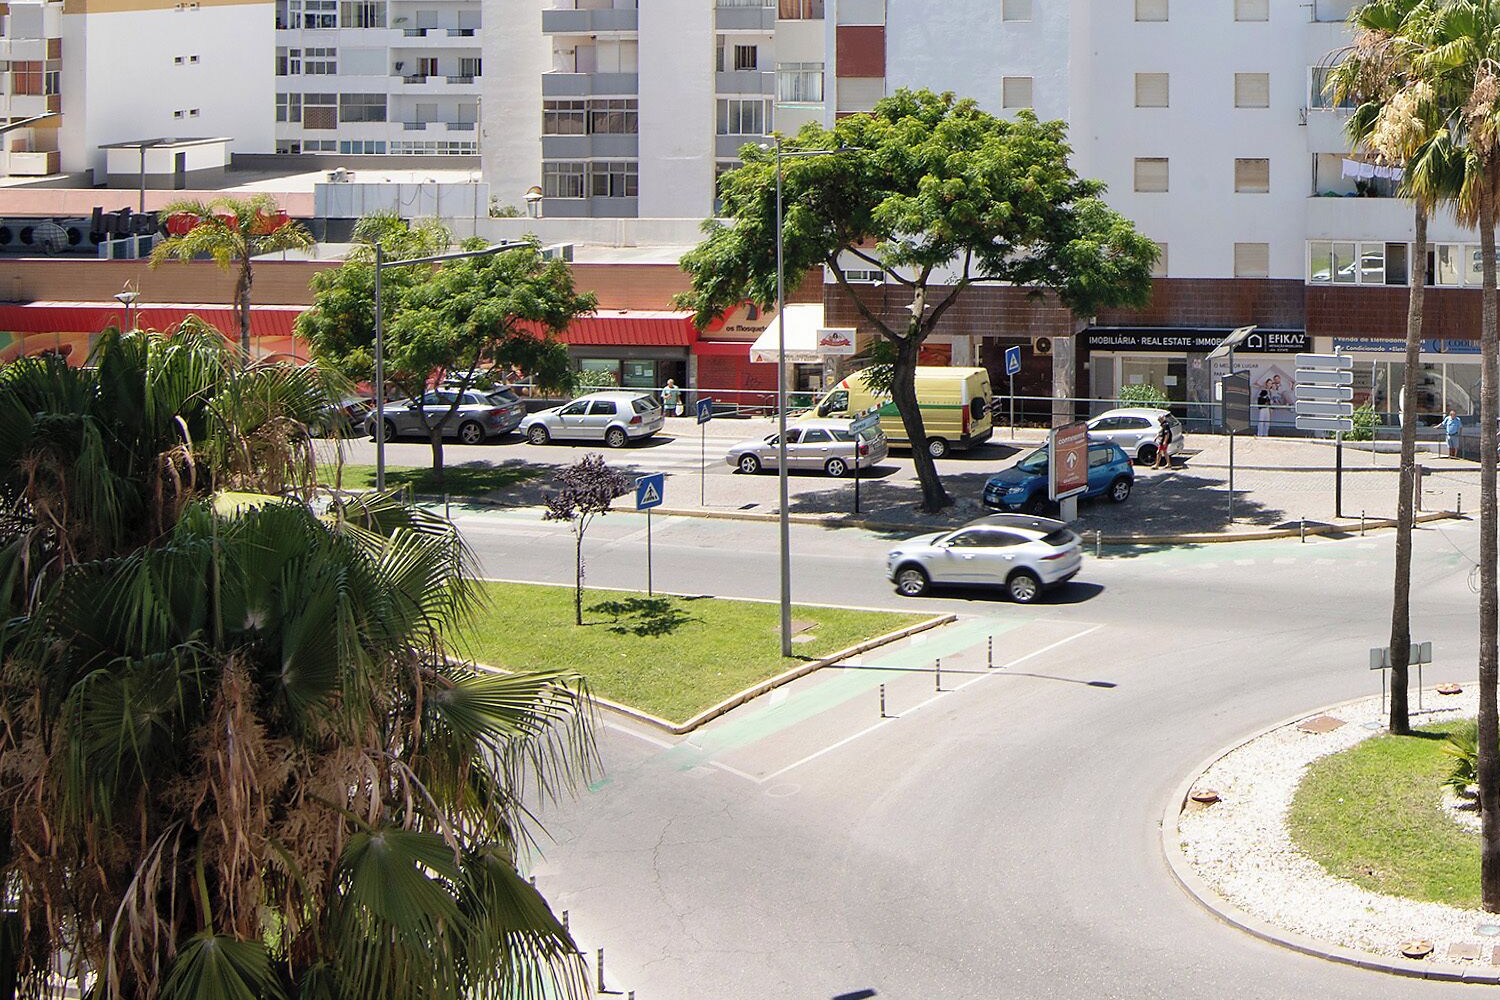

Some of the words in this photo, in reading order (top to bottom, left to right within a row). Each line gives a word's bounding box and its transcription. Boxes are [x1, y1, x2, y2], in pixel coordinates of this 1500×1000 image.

[1088, 334, 1136, 345] IMOBILIÁRIA
[1141, 336, 1162, 345] REAL
[1162, 337, 1192, 346] ESTATE
[1268, 334, 1305, 344] EFIKAZ
